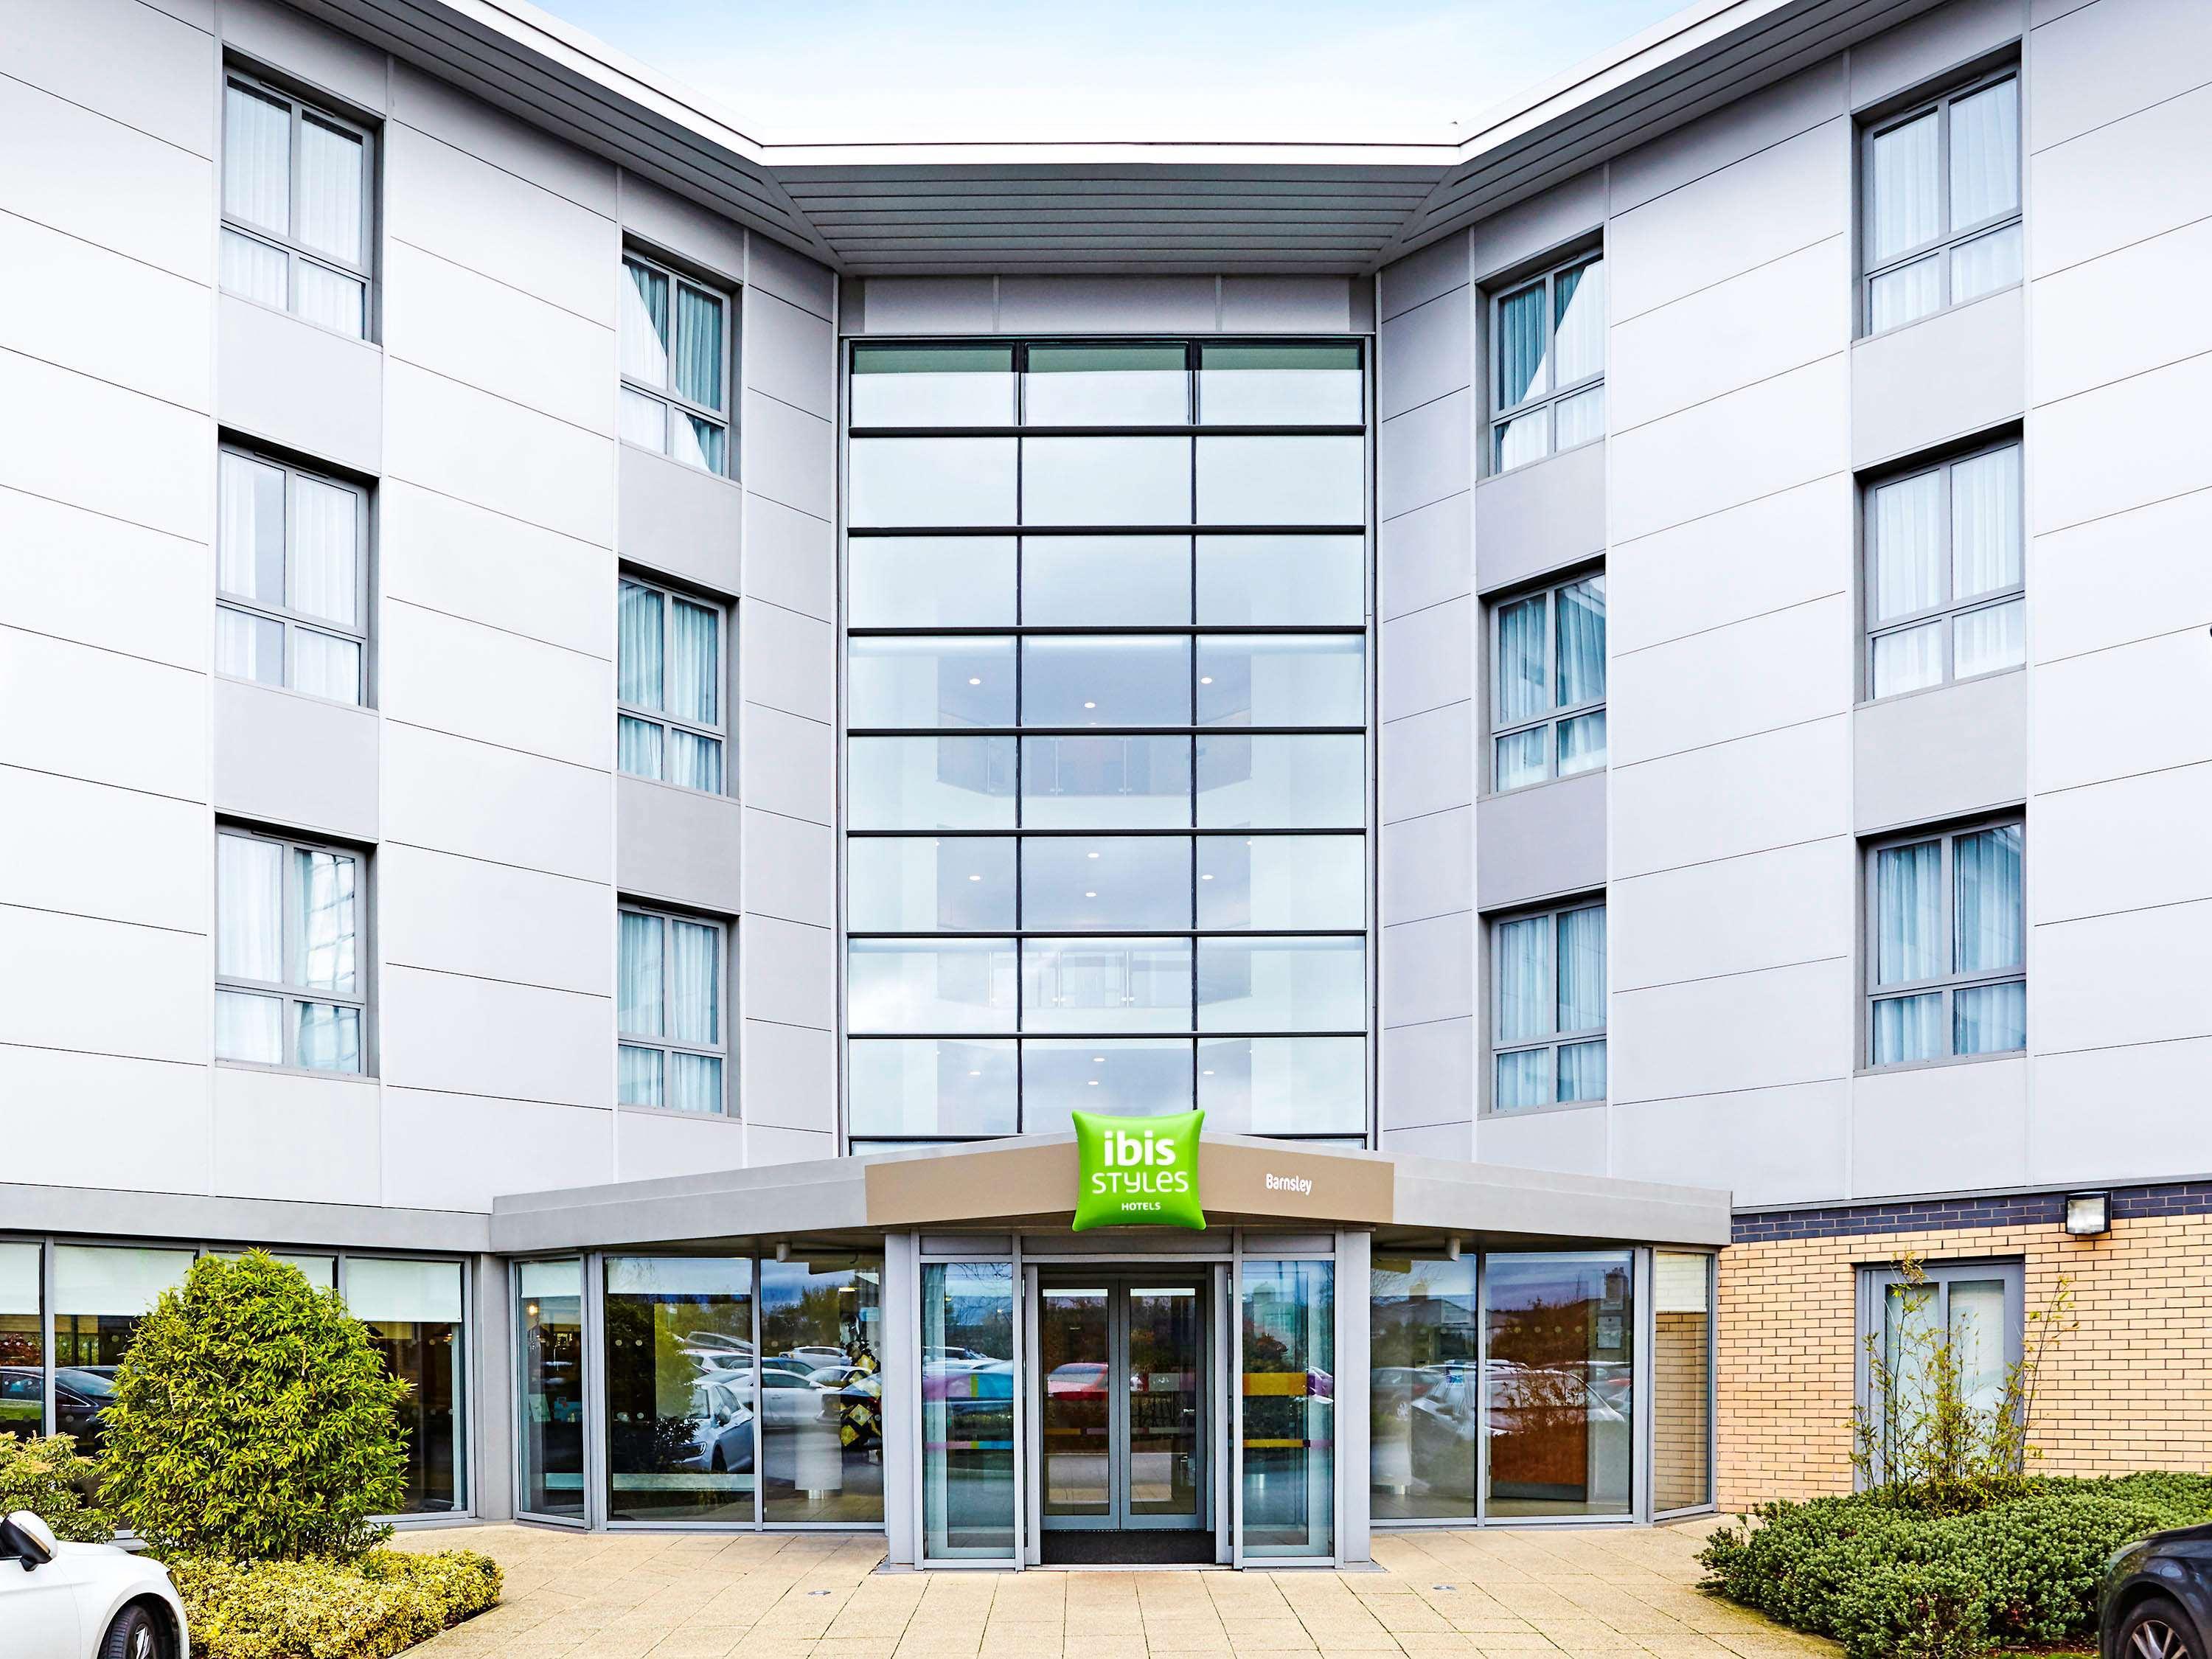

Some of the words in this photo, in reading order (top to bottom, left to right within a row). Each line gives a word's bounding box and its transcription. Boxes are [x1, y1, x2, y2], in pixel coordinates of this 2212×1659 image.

[1104, 1130, 1176, 1166] ibis
[1265, 1173, 1312, 1196] Barnsley
[1121, 1202, 1161, 1211] HOTELS
